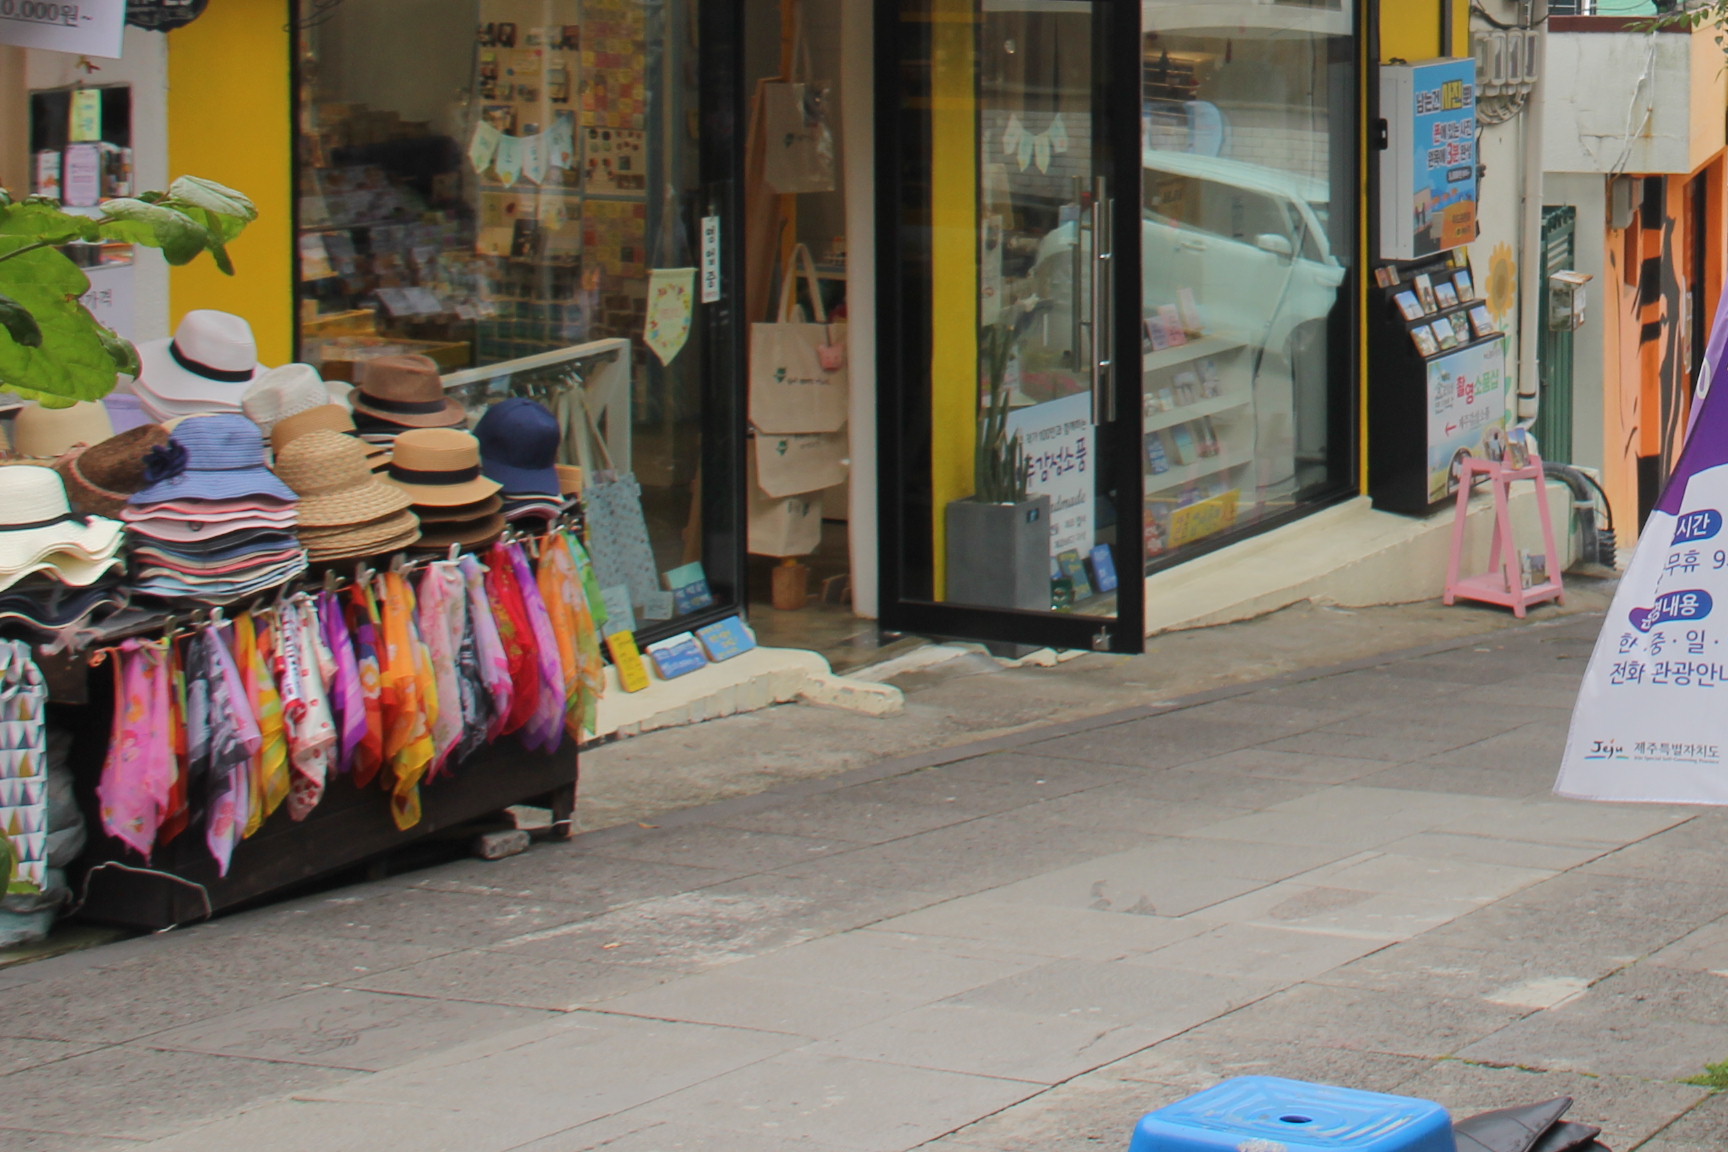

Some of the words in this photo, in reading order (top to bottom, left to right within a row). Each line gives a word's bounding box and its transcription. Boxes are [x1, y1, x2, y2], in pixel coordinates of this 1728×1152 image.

[1610, 660, 1646, 686] 전화
[1590, 738, 1624, 760] Jeju
[1634, 741, 1720, 759] 제주특별자치도
